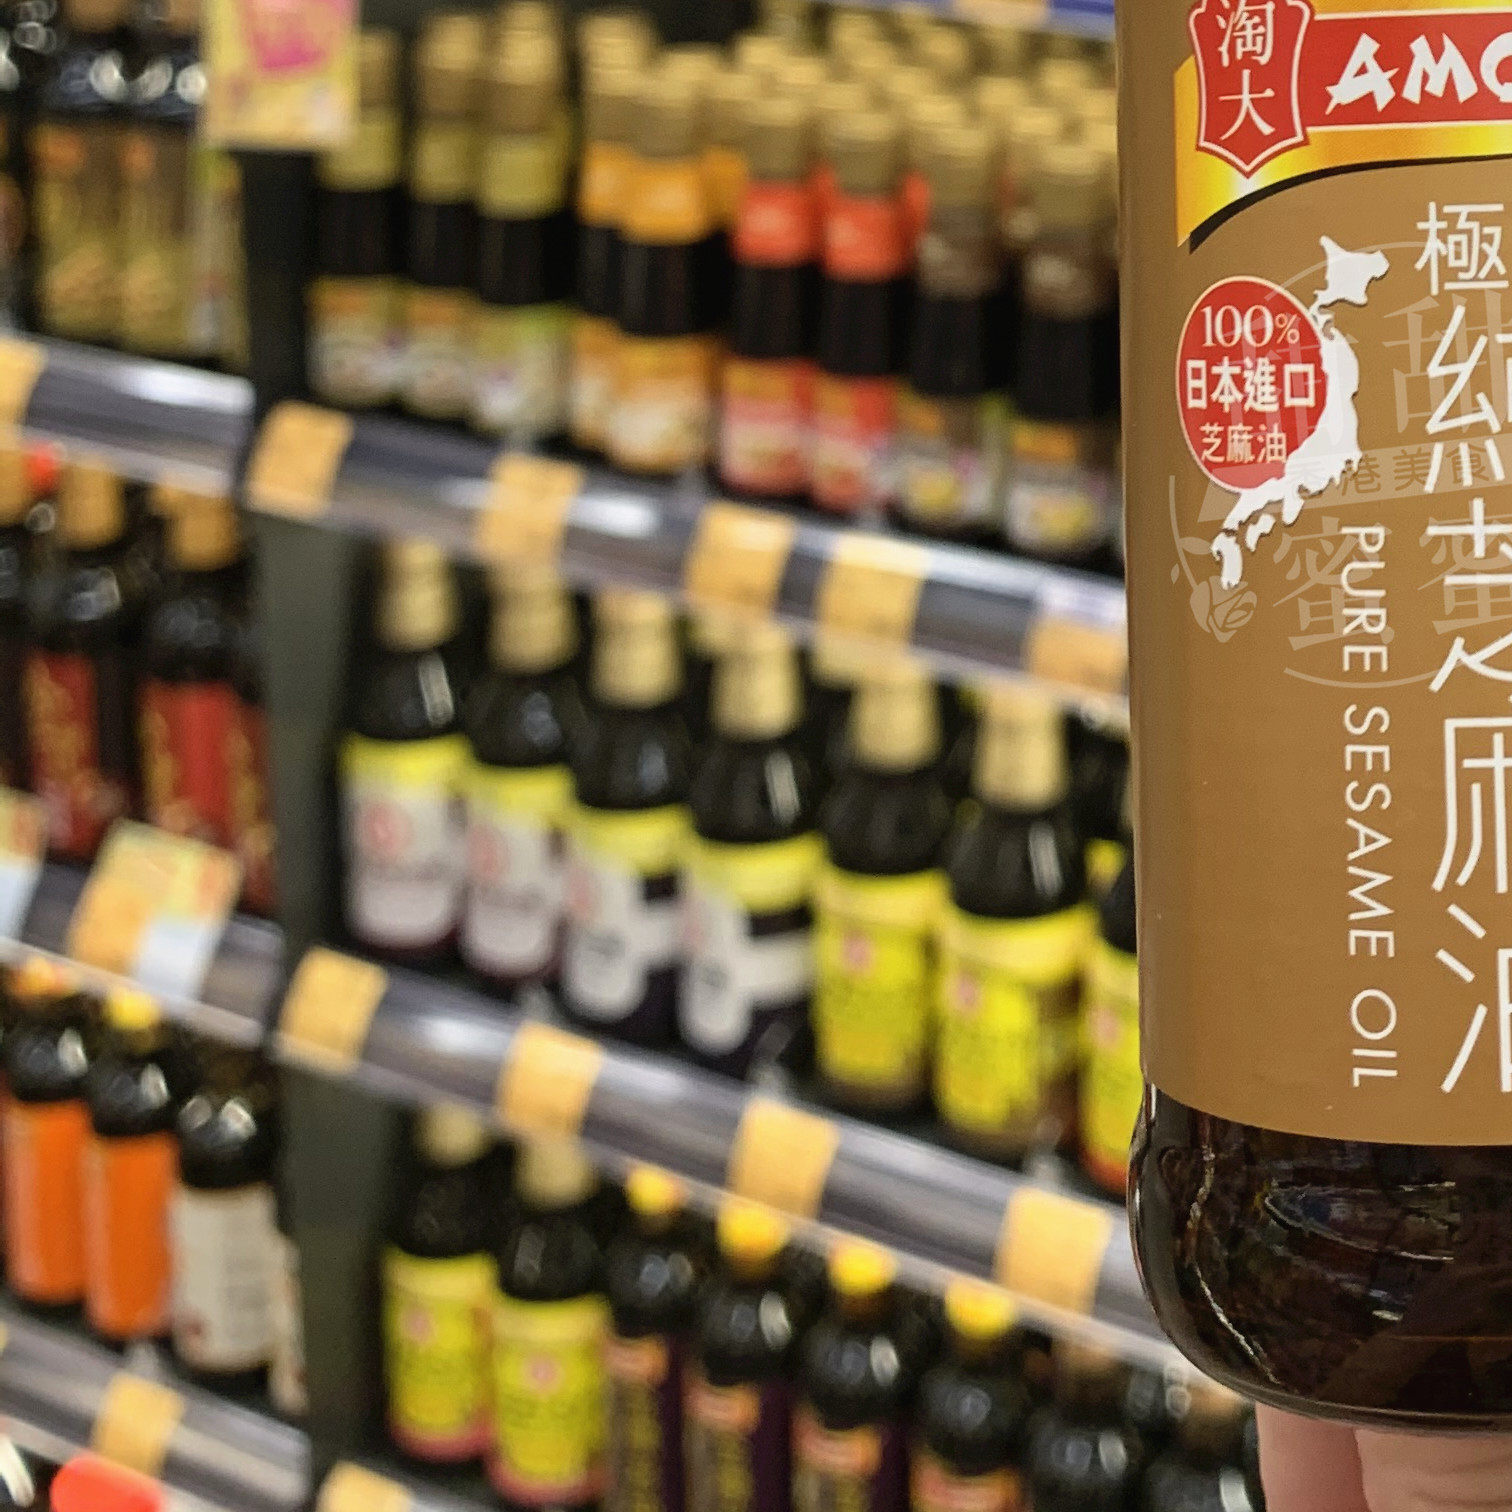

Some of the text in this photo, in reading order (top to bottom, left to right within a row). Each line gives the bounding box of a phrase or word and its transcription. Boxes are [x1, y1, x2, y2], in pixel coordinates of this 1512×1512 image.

[1200, 304, 1300, 347] 100%
[1186, 355, 1316, 413] 日本進口
[1199, 421, 1288, 464] 芝麻油
[1341, 526, 1398, 1088] PURE SESAME OIL
